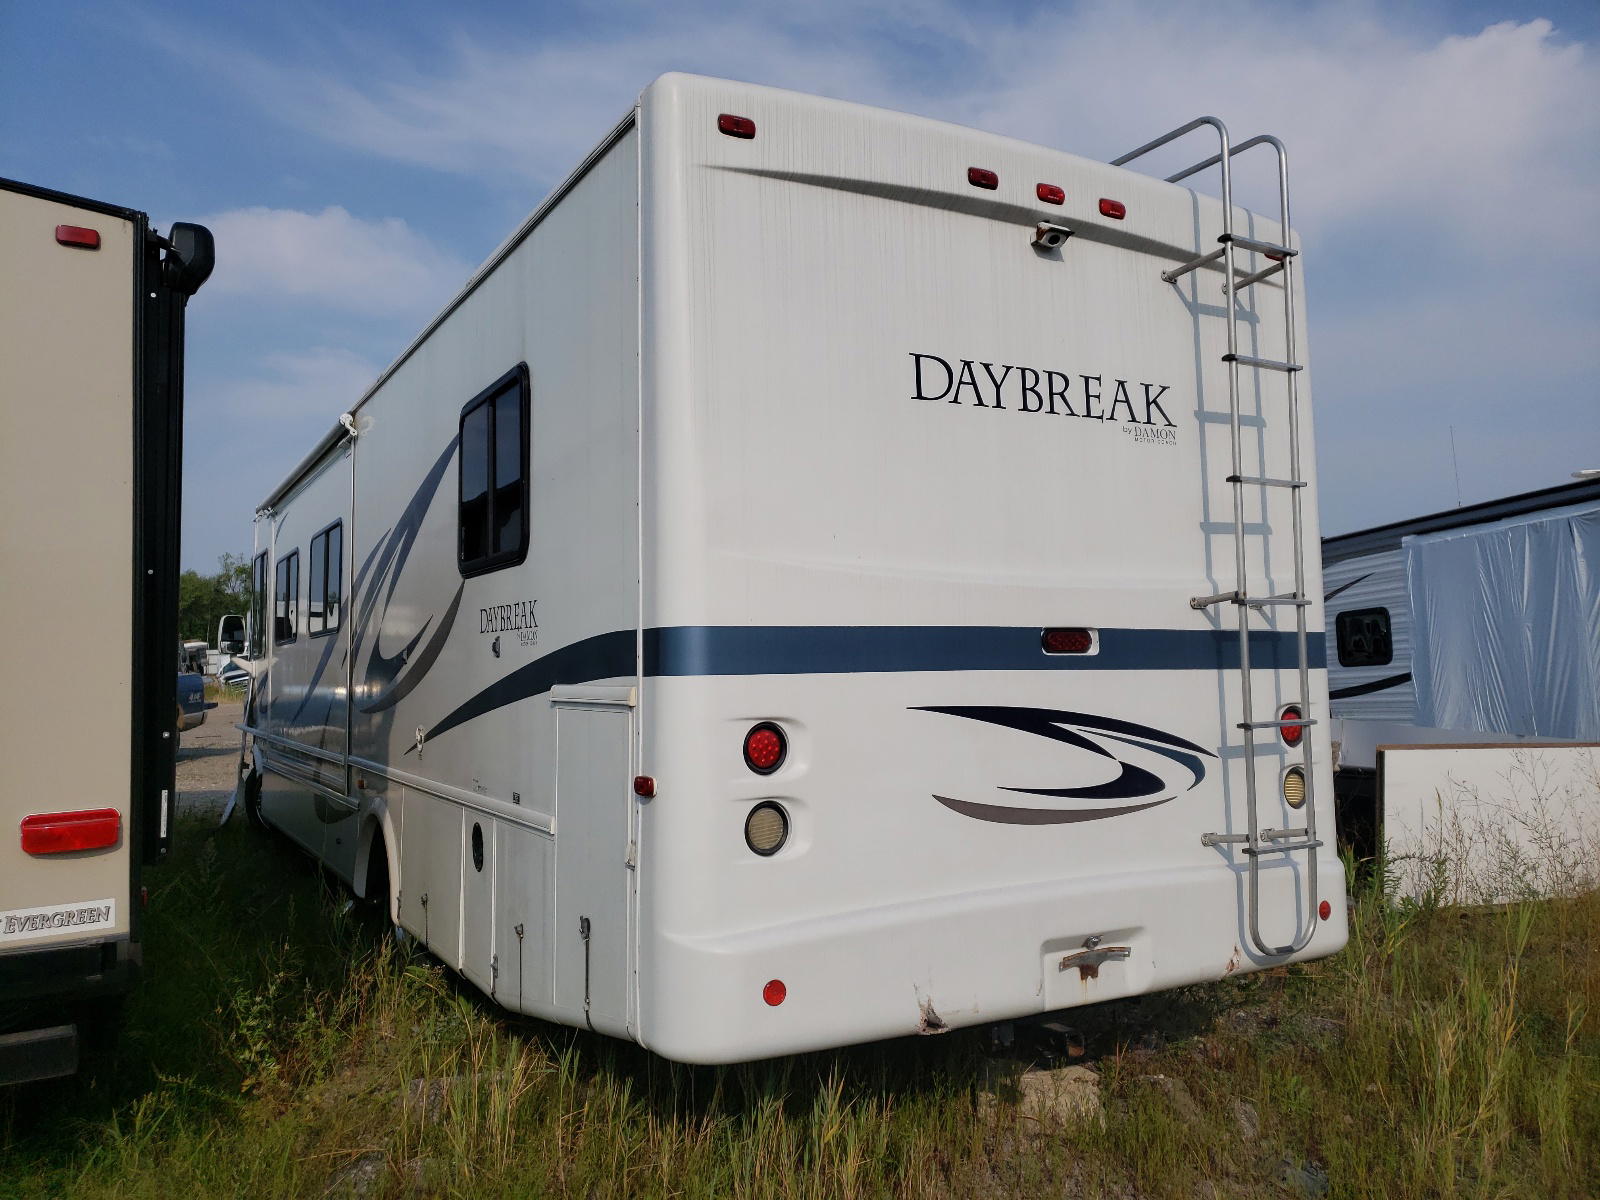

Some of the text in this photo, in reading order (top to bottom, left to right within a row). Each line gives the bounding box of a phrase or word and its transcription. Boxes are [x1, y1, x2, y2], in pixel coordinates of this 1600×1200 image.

[908, 352, 1178, 428] DAYBREAK
[1122, 425, 1176, 440] by DAMON
[479, 599, 539, 634] DAYBREAK
[4, 905, 111, 934] EVERGREEN
